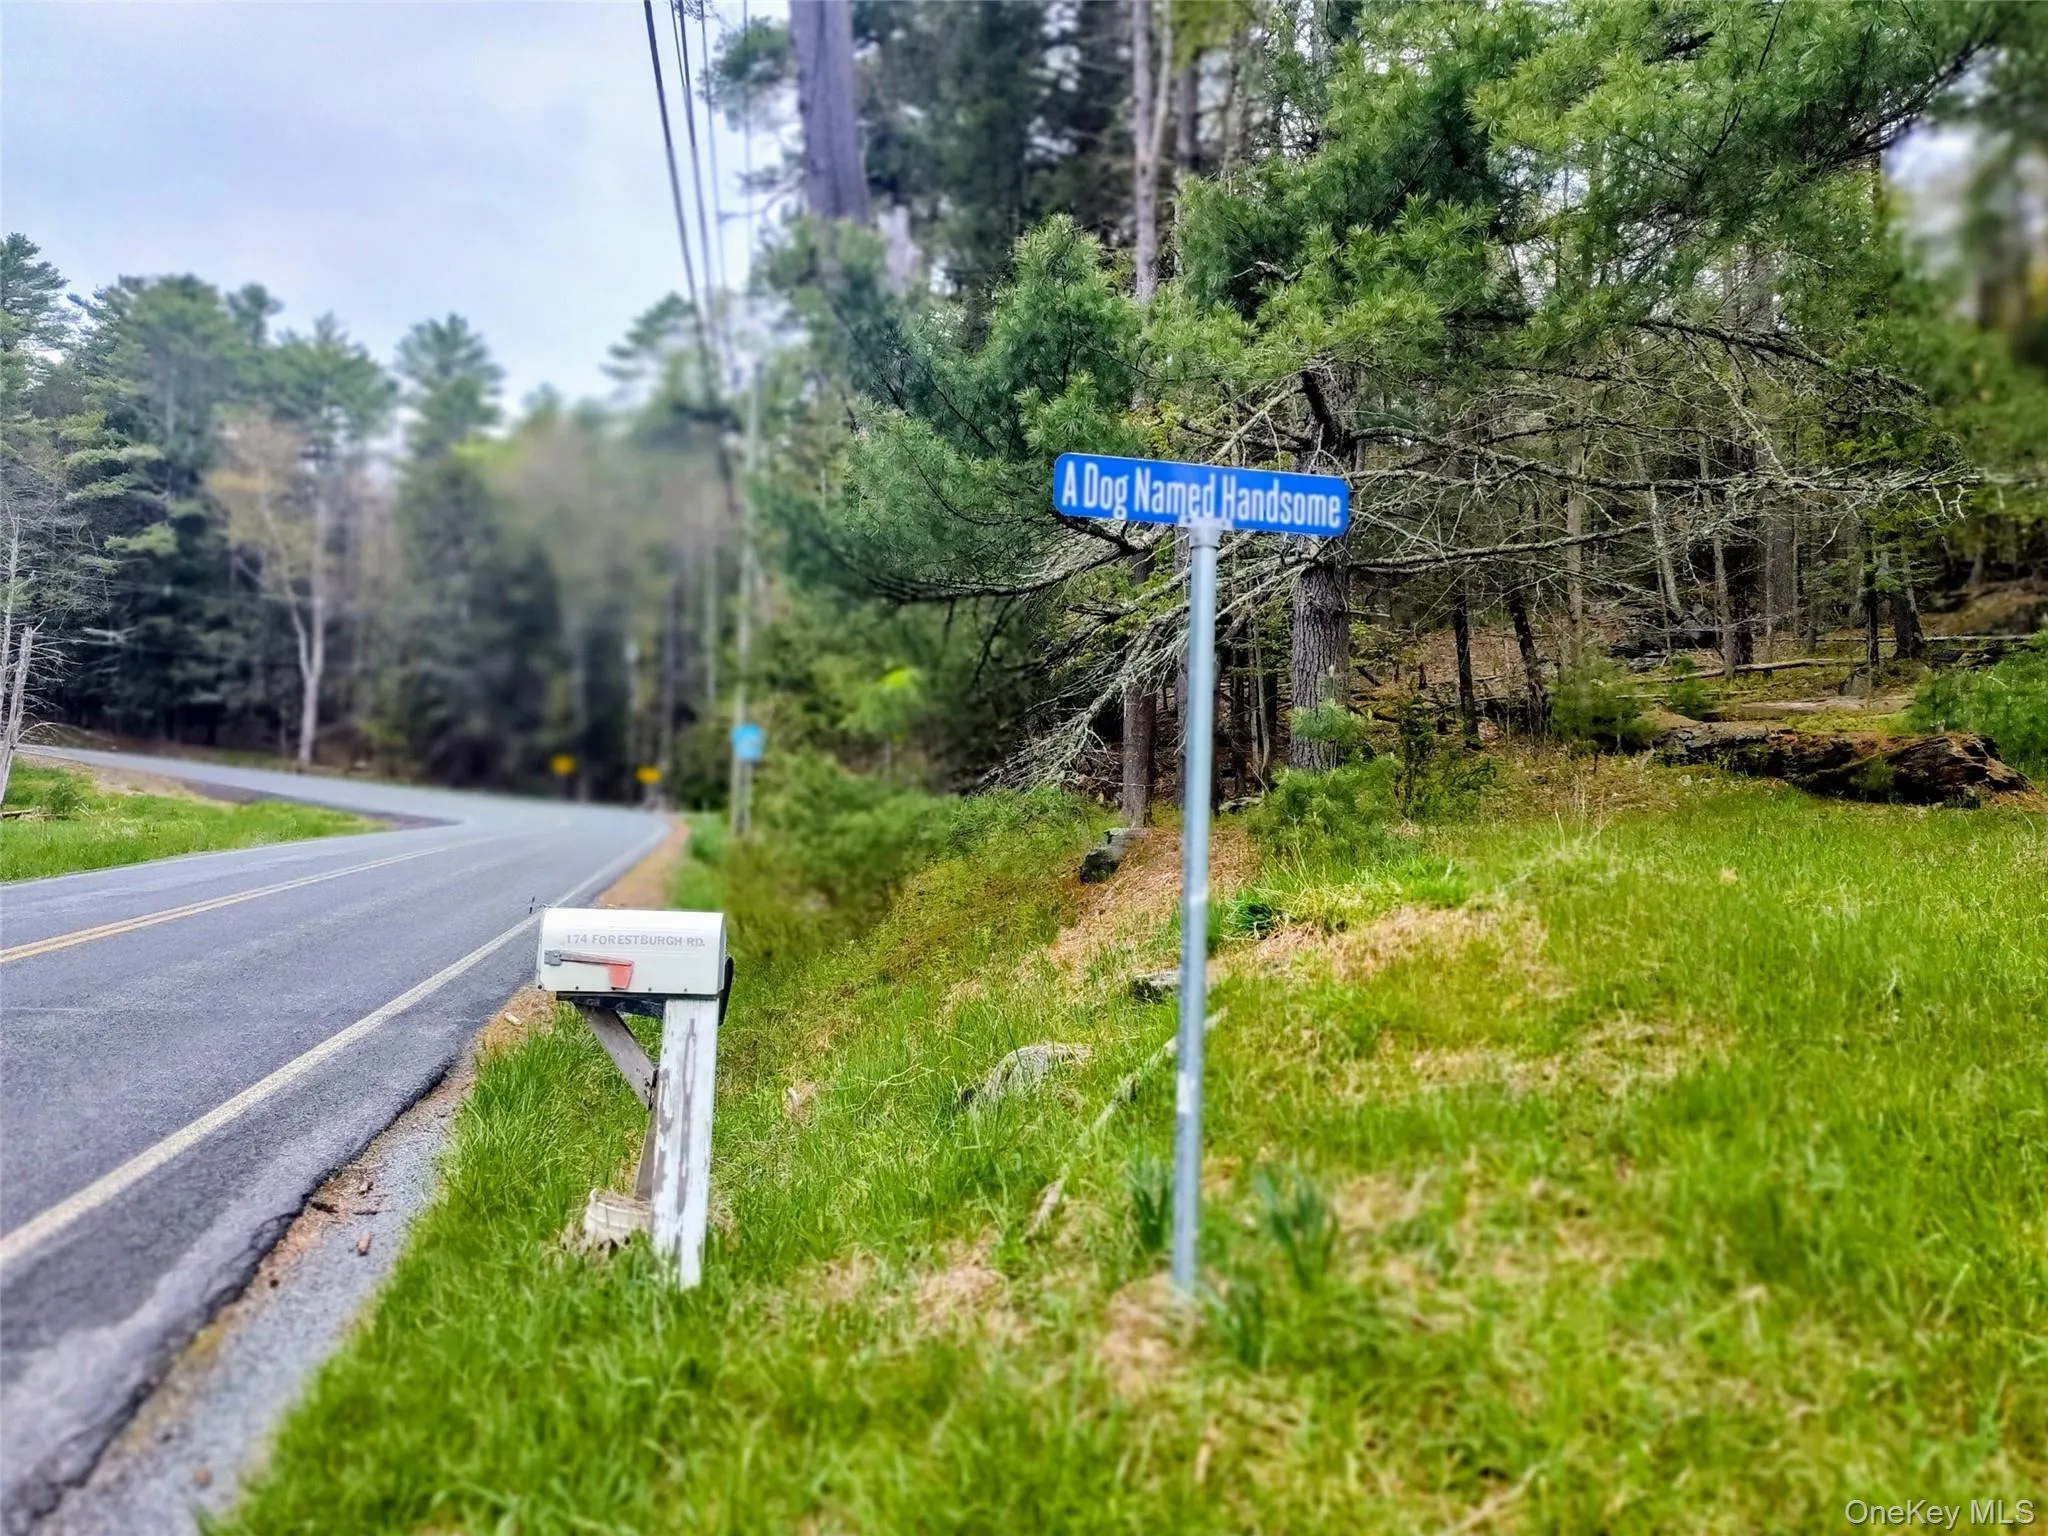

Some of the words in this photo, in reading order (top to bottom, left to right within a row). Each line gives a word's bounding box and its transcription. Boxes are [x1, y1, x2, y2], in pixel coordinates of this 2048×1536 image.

[1061, 461, 1078, 507] A
[1083, 462, 1129, 520] Dog
[1134, 467, 1216, 519] Named
[1221, 475, 1341, 528] Handsome
[566, 934, 588, 944] 174
[592, 934, 682, 946] FORESTBURGH
